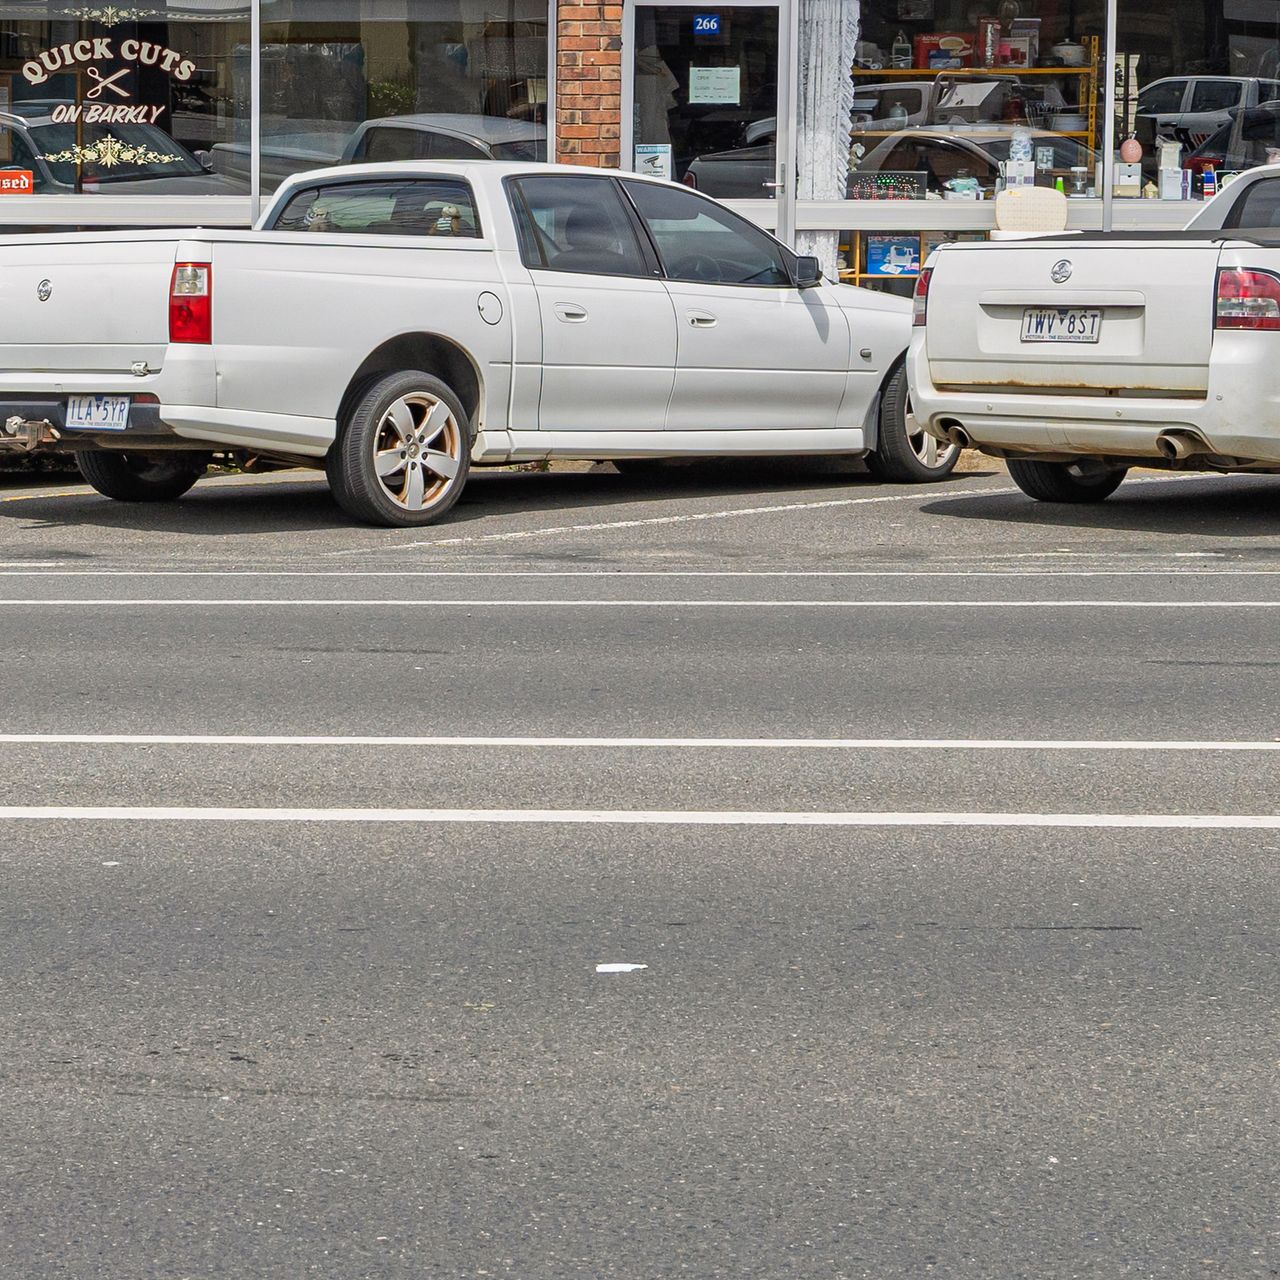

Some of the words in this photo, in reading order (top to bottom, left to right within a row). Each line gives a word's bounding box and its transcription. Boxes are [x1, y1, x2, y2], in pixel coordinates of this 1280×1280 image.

[695, 18, 718, 30] 266
[22, 37, 114, 86] QUICK
[120, 38, 197, 82] CUTS
[51, 105, 83, 123] ON
[85, 105, 166, 124] BARKLY
